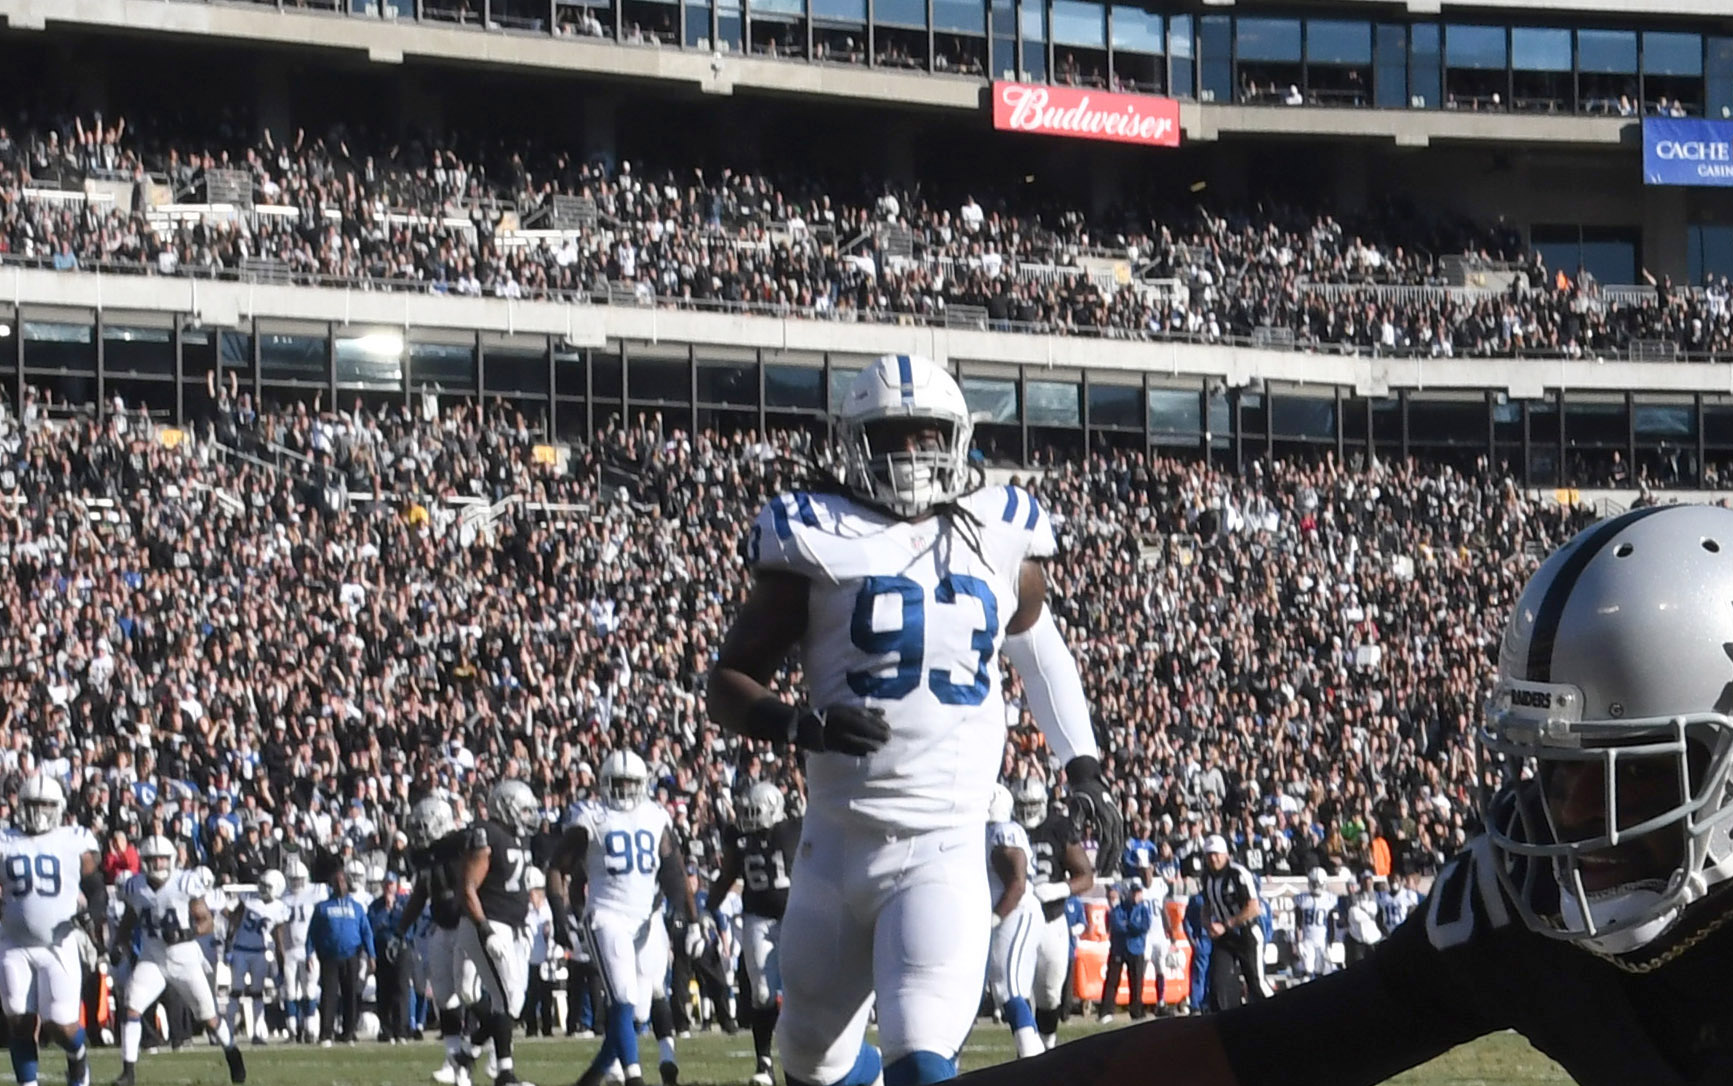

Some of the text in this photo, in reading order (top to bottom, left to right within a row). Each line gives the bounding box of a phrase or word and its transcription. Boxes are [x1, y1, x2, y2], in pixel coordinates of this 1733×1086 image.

[1002, 85, 1172, 139] Budweiser
[1656, 141, 1729, 161] CACHE
[846, 574, 1000, 706] 93
[604, 829, 656, 875] 98
[743, 849, 791, 891] 61
[6, 854, 62, 898] 99
